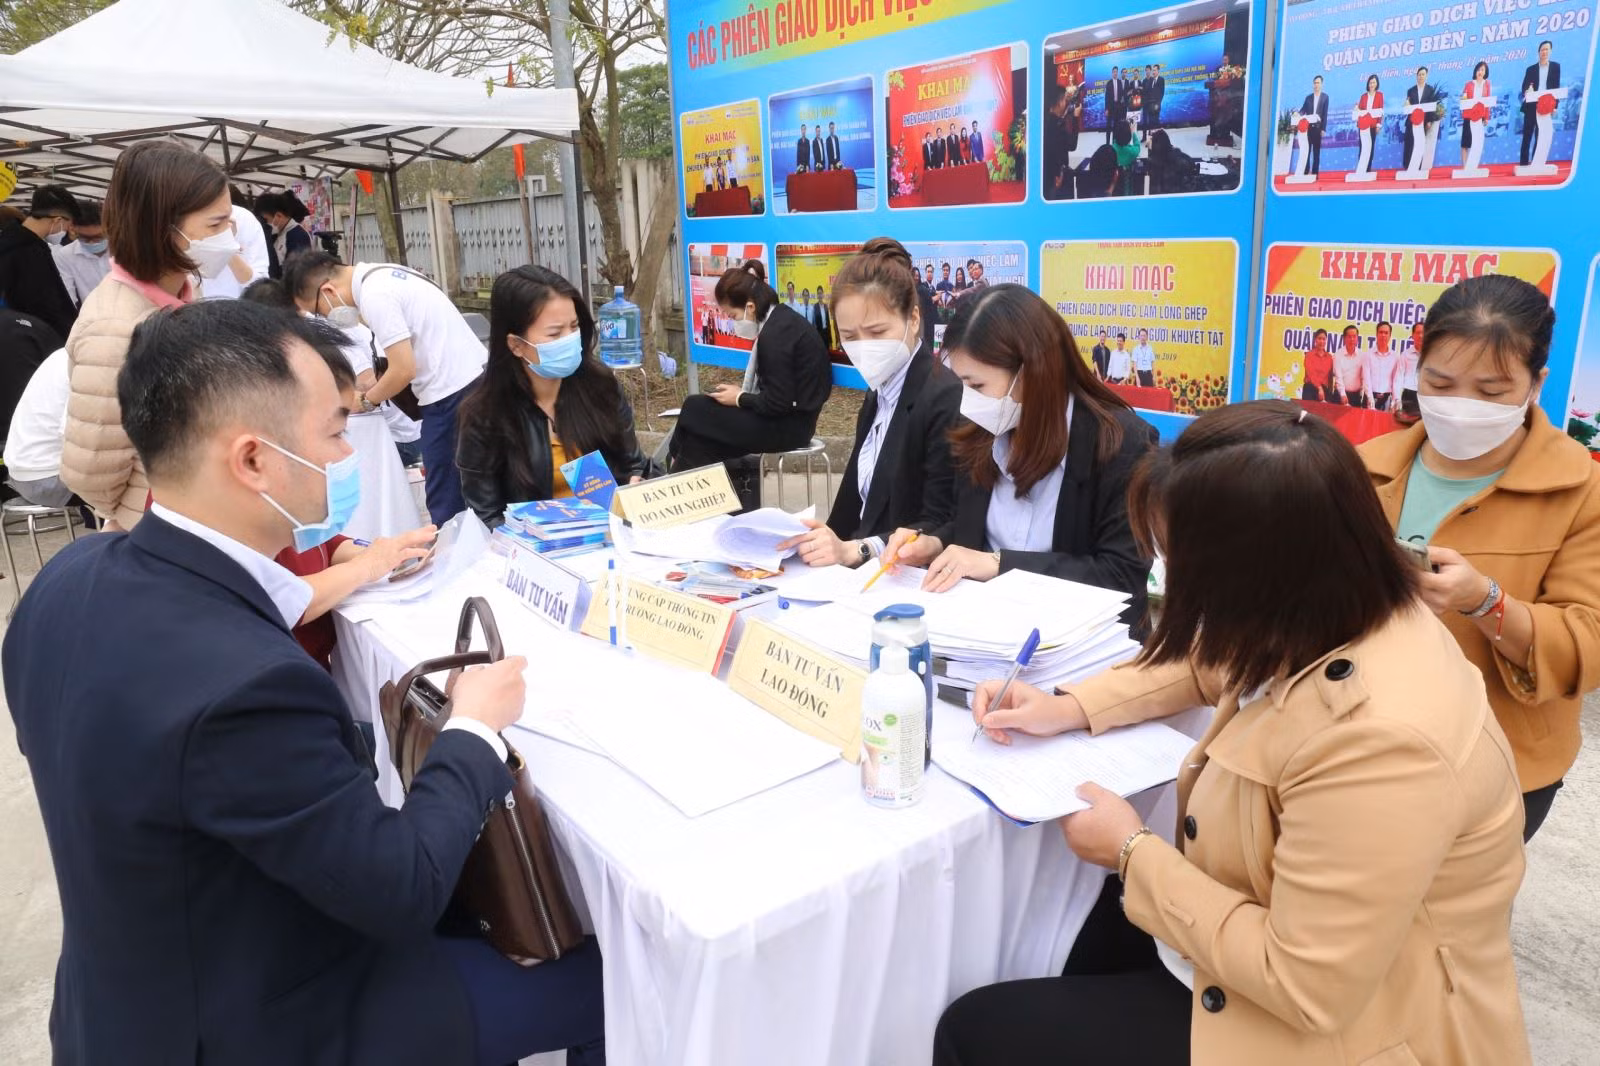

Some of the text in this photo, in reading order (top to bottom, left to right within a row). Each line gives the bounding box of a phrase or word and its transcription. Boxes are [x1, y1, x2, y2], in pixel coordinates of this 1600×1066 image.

[688, 19, 717, 70] CÁC
[720, 3, 770, 61] PHIÊN
[775, 0, 818, 46] GIAO
[1327, 21, 1378, 44] PHIÊN
[1382, 12, 1424, 34] GIAO
[1428, 2, 1478, 27] DỊCH
[1322, 46, 1364, 71] QUẬN
[1368, 40, 1415, 61] LONG
[1420, 29, 1466, 53] BIÊN
[1481, 18, 1531, 44] NĂM
[1535, 8, 1590, 35] 2020
[917, 81, 950, 100] KHAI
[705, 132, 721, 145] KHAI
[1084, 265, 1174, 297] KHAI MẠC
[1320, 250, 1403, 282] KHAI
[1080, 303, 1097, 315] GIAO
[1264, 292, 1426, 330] PHIÊN GIAO DỊCH VIỆC
[1161, 352, 1178, 361] 2019
[685, 474, 711, 492] VẤN
[639, 491, 727, 524] DOANH NGHIỆP
[506, 567, 568, 625] BÀN TƯ VẤN
[667, 599, 699, 620] THÔNG
[700, 611, 717, 625] TIN
[657, 615, 676, 631] LAO
[766, 640, 844, 694] BÀN TƯ VẤN
[760, 668, 829, 718] LAO ĐỘNG
